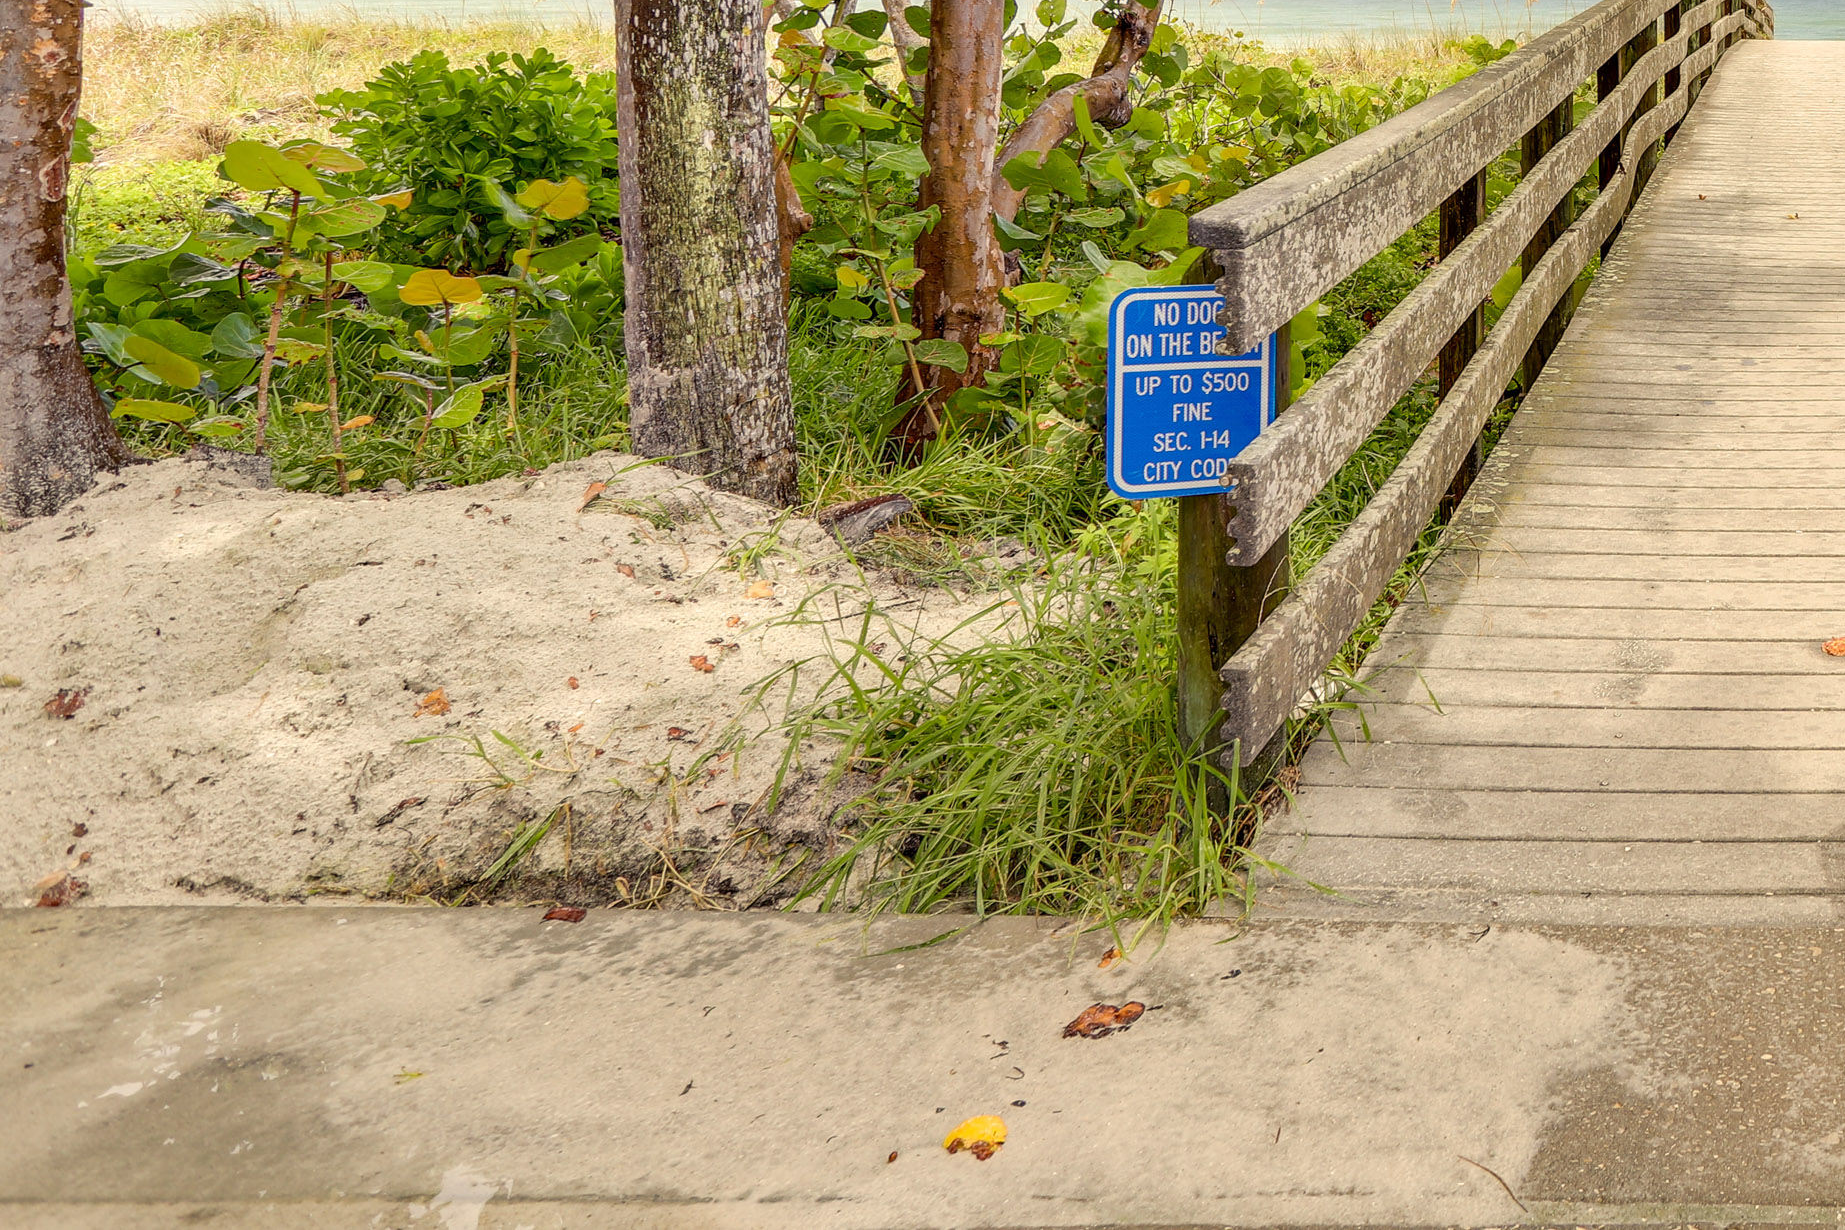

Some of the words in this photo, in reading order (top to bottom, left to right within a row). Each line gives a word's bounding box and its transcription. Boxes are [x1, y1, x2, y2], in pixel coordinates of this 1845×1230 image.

[1154, 302, 1180, 327] NO
[1126, 334, 1153, 358] ON
[1159, 332, 1193, 357] THE
[1135, 376, 1161, 396] UP
[1170, 374, 1192, 394] TO
[1201, 371, 1250, 395] $500
[1172, 402, 1213, 423] FINE
[1153, 431, 1192, 453] SEC.
[1200, 429, 1230, 450] 1-14
[1143, 461, 1183, 482] CITY
[1190, 457, 1234, 479] COD
